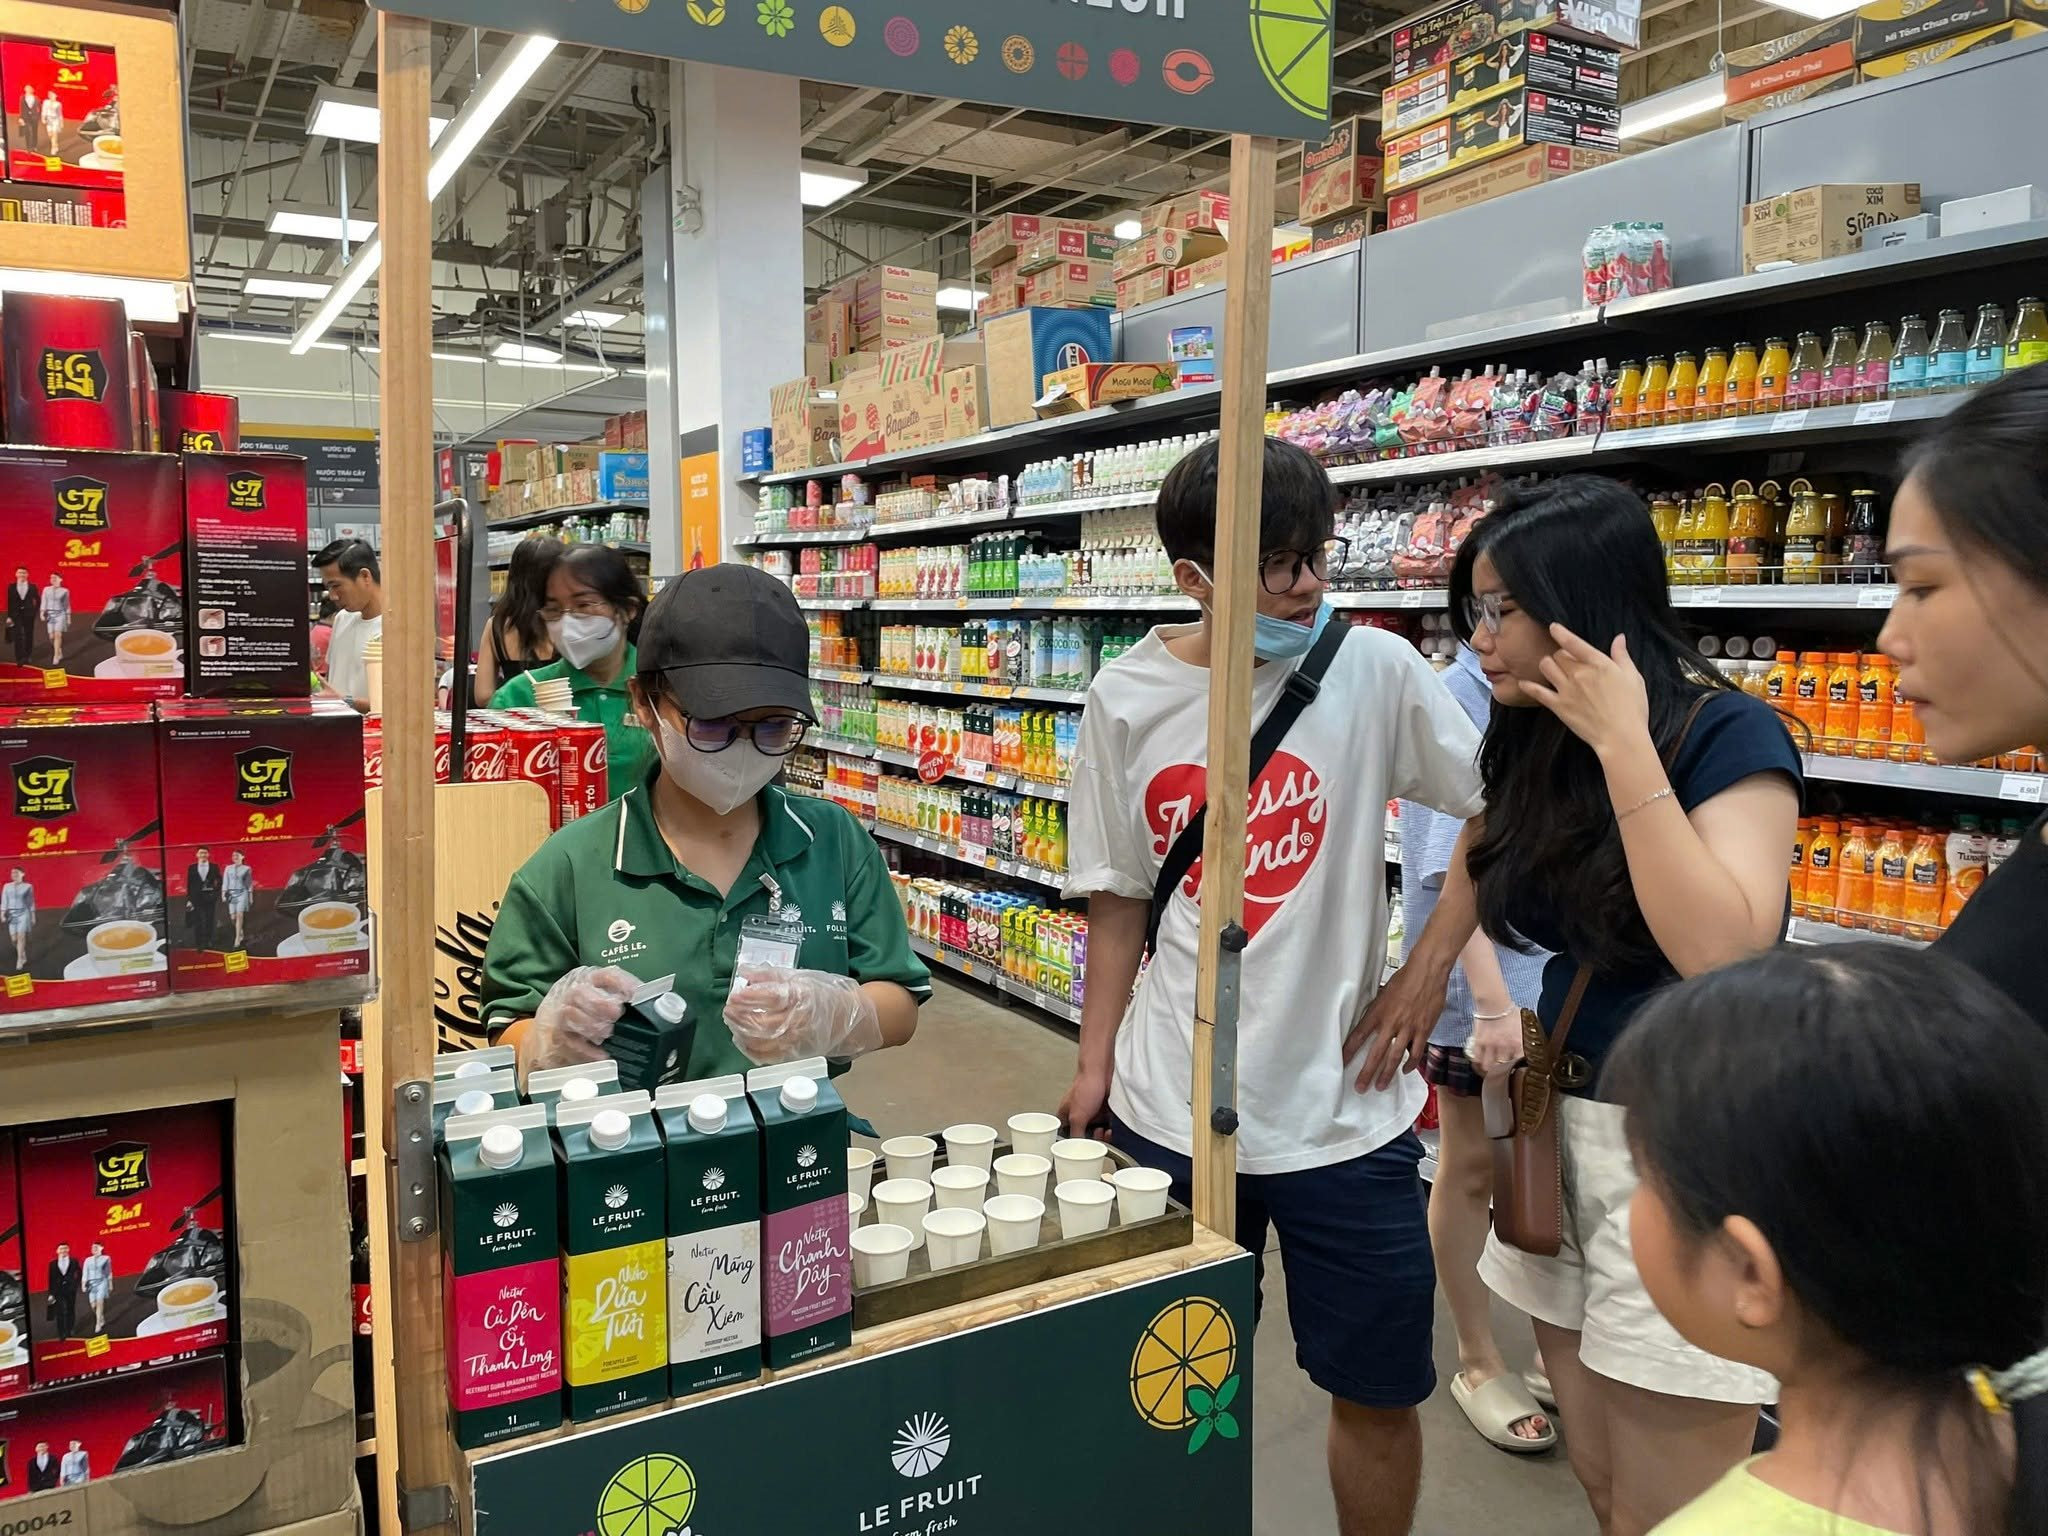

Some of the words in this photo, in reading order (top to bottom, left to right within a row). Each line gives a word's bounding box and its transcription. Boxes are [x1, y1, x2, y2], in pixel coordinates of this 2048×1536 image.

[1922, 16, 1950, 31] Chua
[1951, 11, 1972, 27] Cay
[1762, 73, 1785, 87] Chua
[1866, 195, 1884, 205] XIM
[1391, 212, 1415, 228] VIFON
[1754, 210, 1772, 222] XIM
[1061, 244, 1083, 254] VIFON
[229, 480, 263, 497] G7
[57, 488, 104, 512] G7
[64, 538, 102, 560] 3in1
[241, 758, 288, 783] G7
[18, 768, 71, 796] G7
[27, 797, 41, 805] CÀ
[246, 812, 285, 834] 3in1
[27, 826, 69, 850] 3in1
[601, 943, 629, 958] CAFÉS
[98, 1150, 145, 1178] G7
[786, 1175, 798, 1184] LE
[690, 1197, 703, 1207] LE
[105, 1202, 143, 1226] 3in1
[592, 1216, 605, 1226] LE
[479, 1234, 494, 1246] LE
[803, 1226, 833, 1245] Nectar
[690, 1243, 718, 1259] Nectar
[778, 1237, 846, 1274] Chanh
[709, 1253, 755, 1284] Mãng
[498, 1285, 528, 1301] Nectar
[794, 1262, 842, 1302] Dây
[683, 1281, 721, 1313] Cầu
[508, 1300, 547, 1327] Dền
[706, 1304, 745, 1335] Xiêm
[463, 1351, 520, 1377] Thanh
[521, 1347, 558, 1372] Long
[860, 1504, 890, 1532] LE
[900, 1474, 983, 1519] FRUIT
[925, 1514, 958, 1536] fresh
